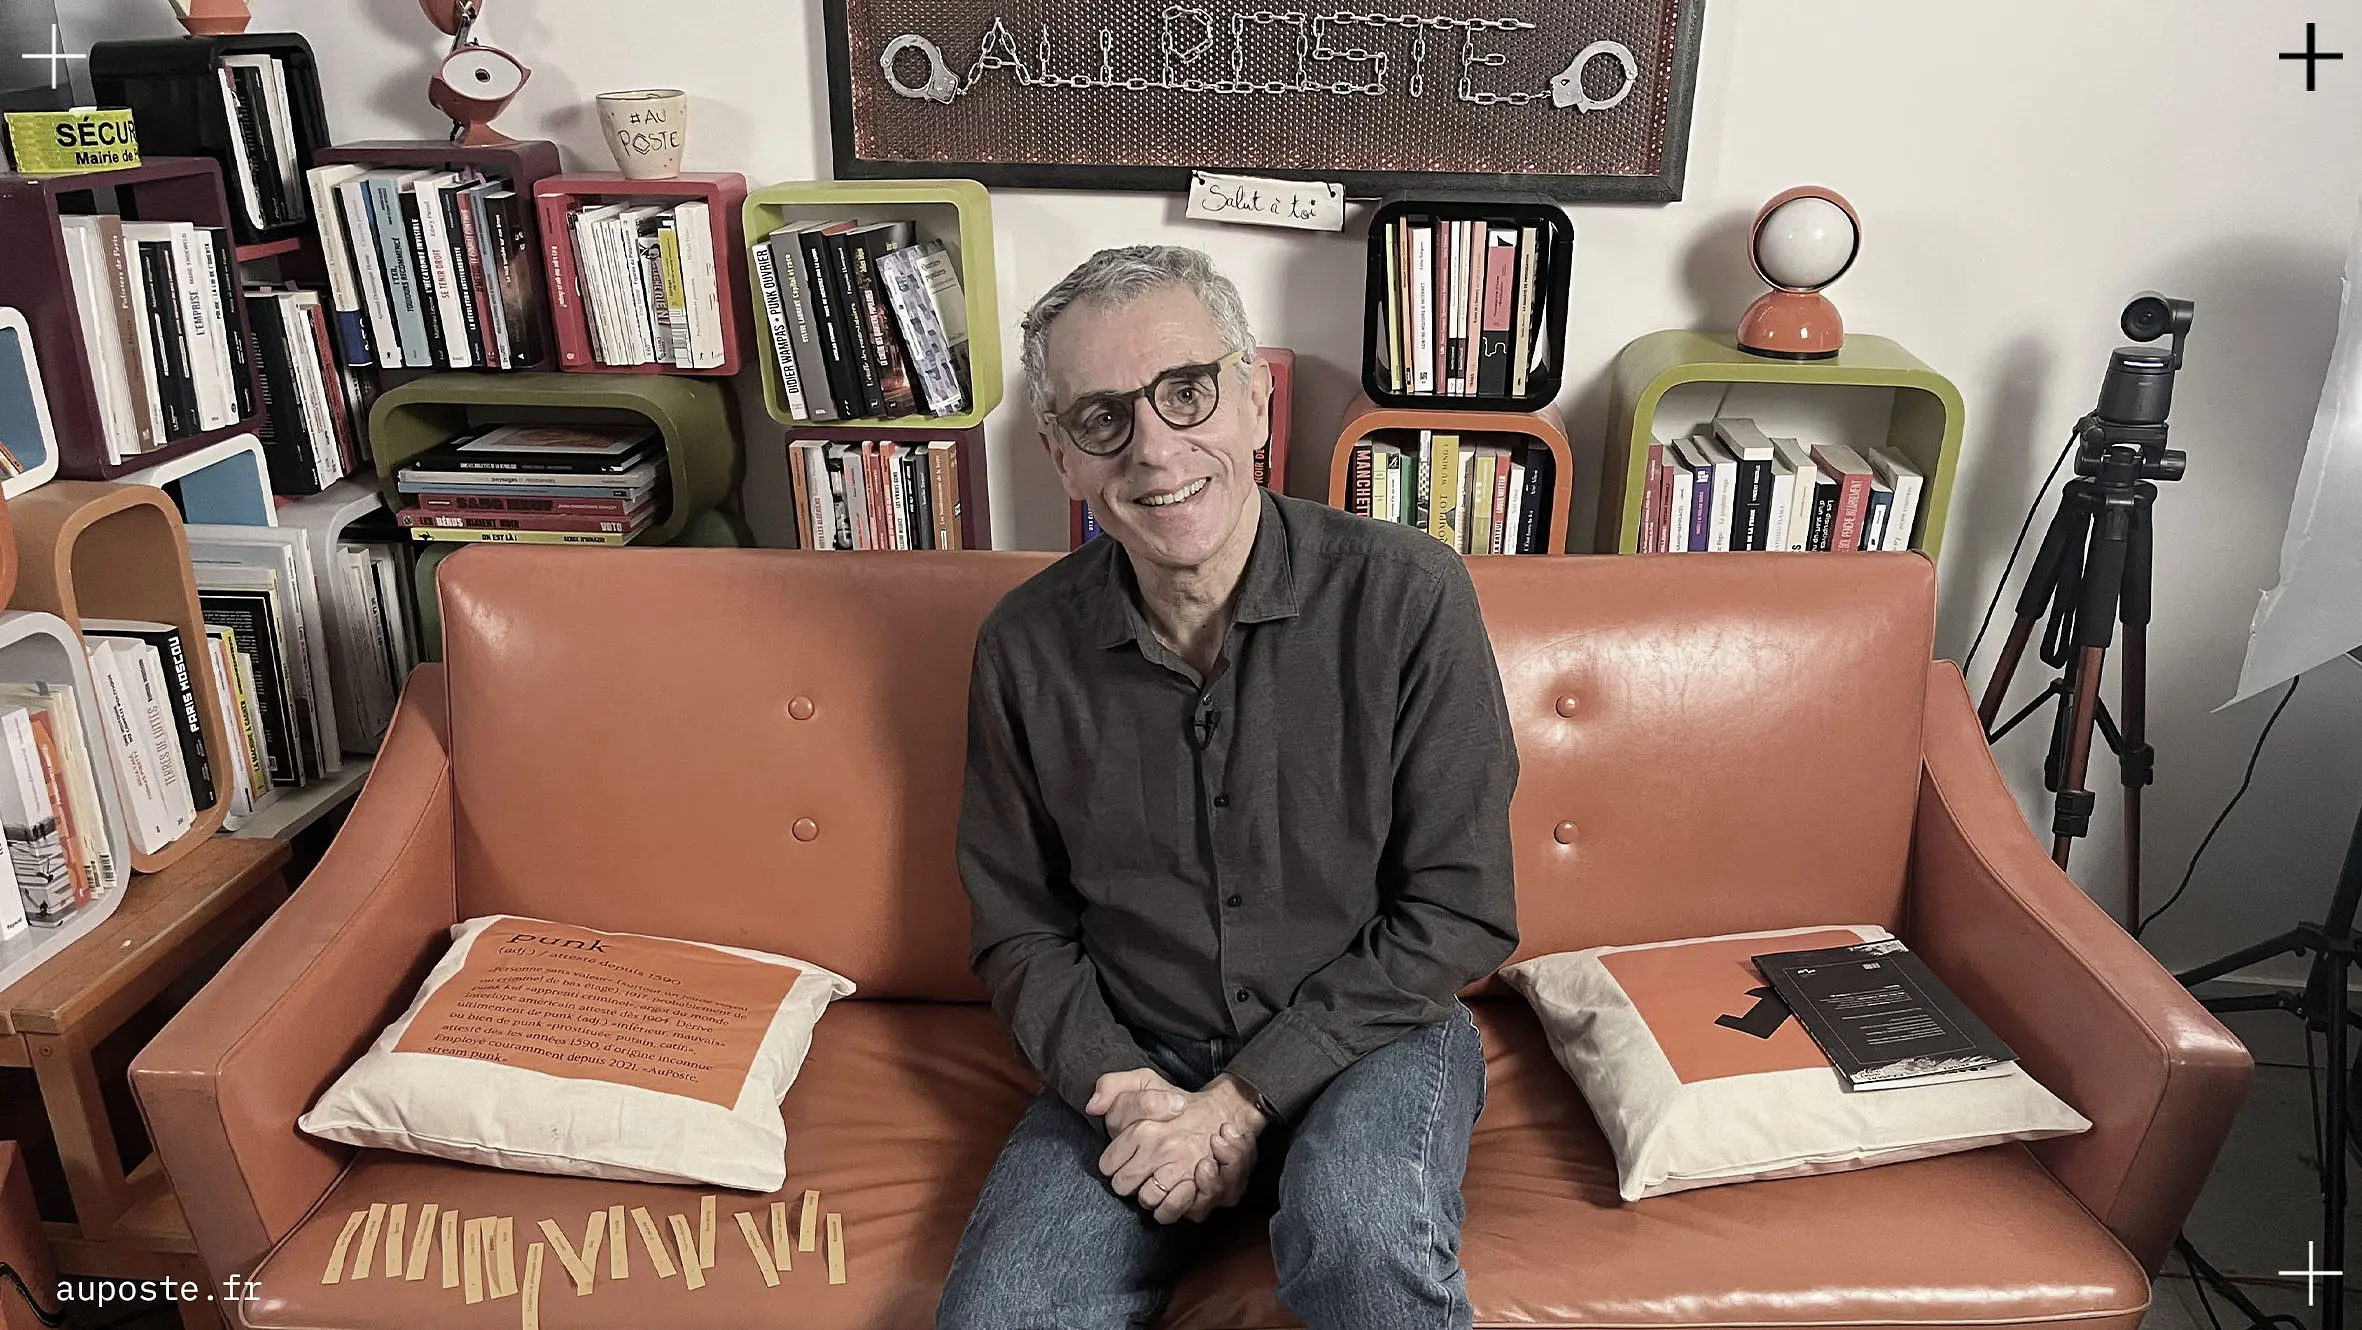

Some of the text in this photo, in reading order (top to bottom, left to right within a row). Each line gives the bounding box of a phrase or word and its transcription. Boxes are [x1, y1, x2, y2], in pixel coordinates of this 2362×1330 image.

[630, 108, 667, 124] #AU
[617, 129, 680, 157] POSTE
[75, 149, 133, 165] Mairie de
[1202, 185, 1316, 220] Salut à toi
[410, 218, 432, 293] L'HÉCATOMBE INVISIBLE
[784, 253, 794, 268] race
[432, 248, 449, 298] SE TENIR DROIT
[401, 281, 413, 312] TOUJOURS
[789, 275, 800, 298] Capital
[188, 289, 206, 336] L'EMPRISE
[756, 249, 799, 394] DIDIER WAMPAS PUNK OUVRIER
[1254, 461, 1264, 484] NOIR
[1440, 472, 1447, 484] WU
[1825, 499, 1833, 511] Les
[435, 516, 463, 527] BÉRUS
[599, 521, 623, 532] VOTO
[1812, 500, 1824, 543] d'un start-up
[107, 673, 122, 706] POLITIQUE
[167, 636, 200, 732] PARIS MOSCOU
[146, 705, 176, 786] TERRES DE LUTTES
[507, 934, 610, 953] punk
[550, 952, 597, 963] attesté
[599, 960, 644, 977] depuis
[648, 973, 681, 985] 1590
[457, 1001, 524, 1015] ultimement
[543, 1011, 574, 1020] punk
[562, 979, 582, 987] bas
[734, 1012, 748, 1020] de
[579, 1004, 618, 1016] attesté
[620, 1011, 638, 1020] dès
[467, 1013, 493, 1022] bien
[496, 1016, 511, 1024] de
[512, 1019, 543, 1028] punk
[640, 1005, 670, 1014] argot
[672, 1009, 687, 1017] du
[690, 1013, 729, 1027] monde
[426, 1046, 468, 1057] stream
[434, 1033, 486, 1046] Employé
[488, 1040, 564, 1061] couramment
[567, 1053, 606, 1065] depuis
[441, 1024, 482, 1033] attesté
[484, 1027, 504, 1036] dès
[525, 1032, 566, 1045] années
[603, 1044, 656, 1061] d'origine
[657, 1056, 714, 1071] inconnue
